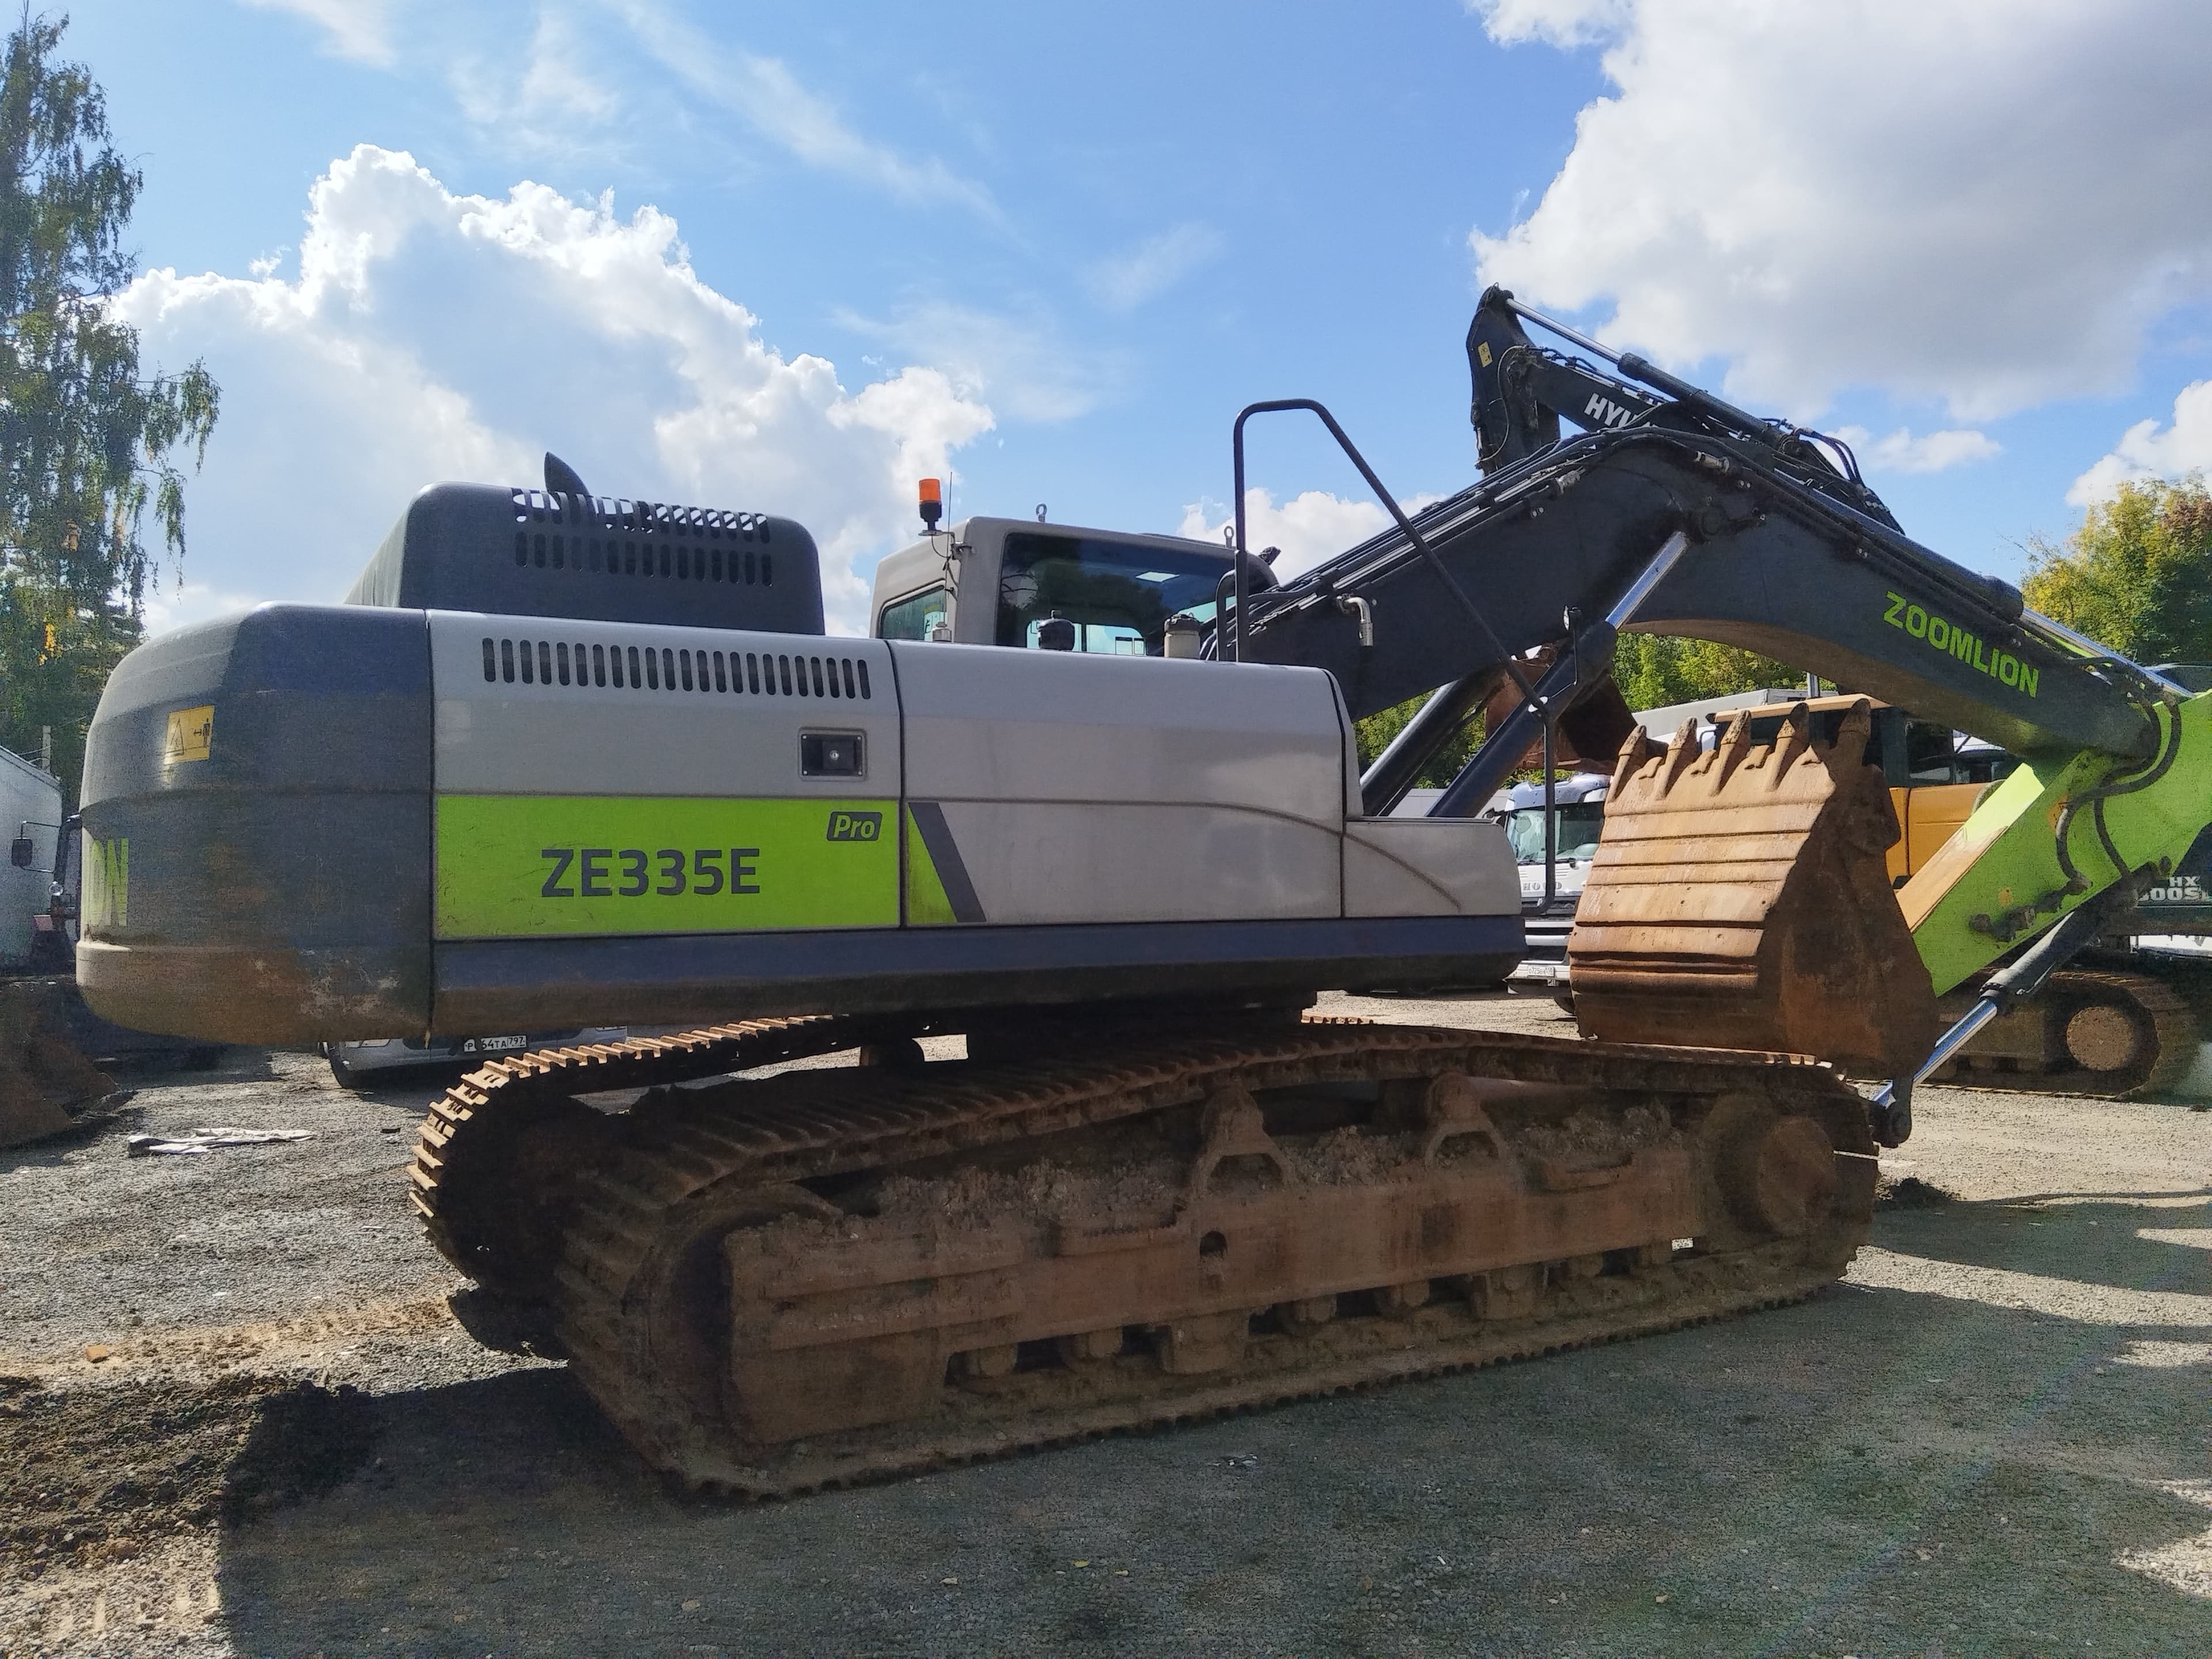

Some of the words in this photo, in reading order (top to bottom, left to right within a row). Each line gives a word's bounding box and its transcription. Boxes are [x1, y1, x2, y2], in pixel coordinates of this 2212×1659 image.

[1584, 392, 1658, 429] HYU
[1883, 590, 2039, 698] ZOOMLION
[834, 815, 875, 838] Pro
[541, 848, 760, 897] ZE335E
[2169, 876, 2199, 887] HX
[1523, 881, 1562, 891] HOO
[467, 1039, 506, 1050] P64TA
[508, 1037, 524, 1045] 797
